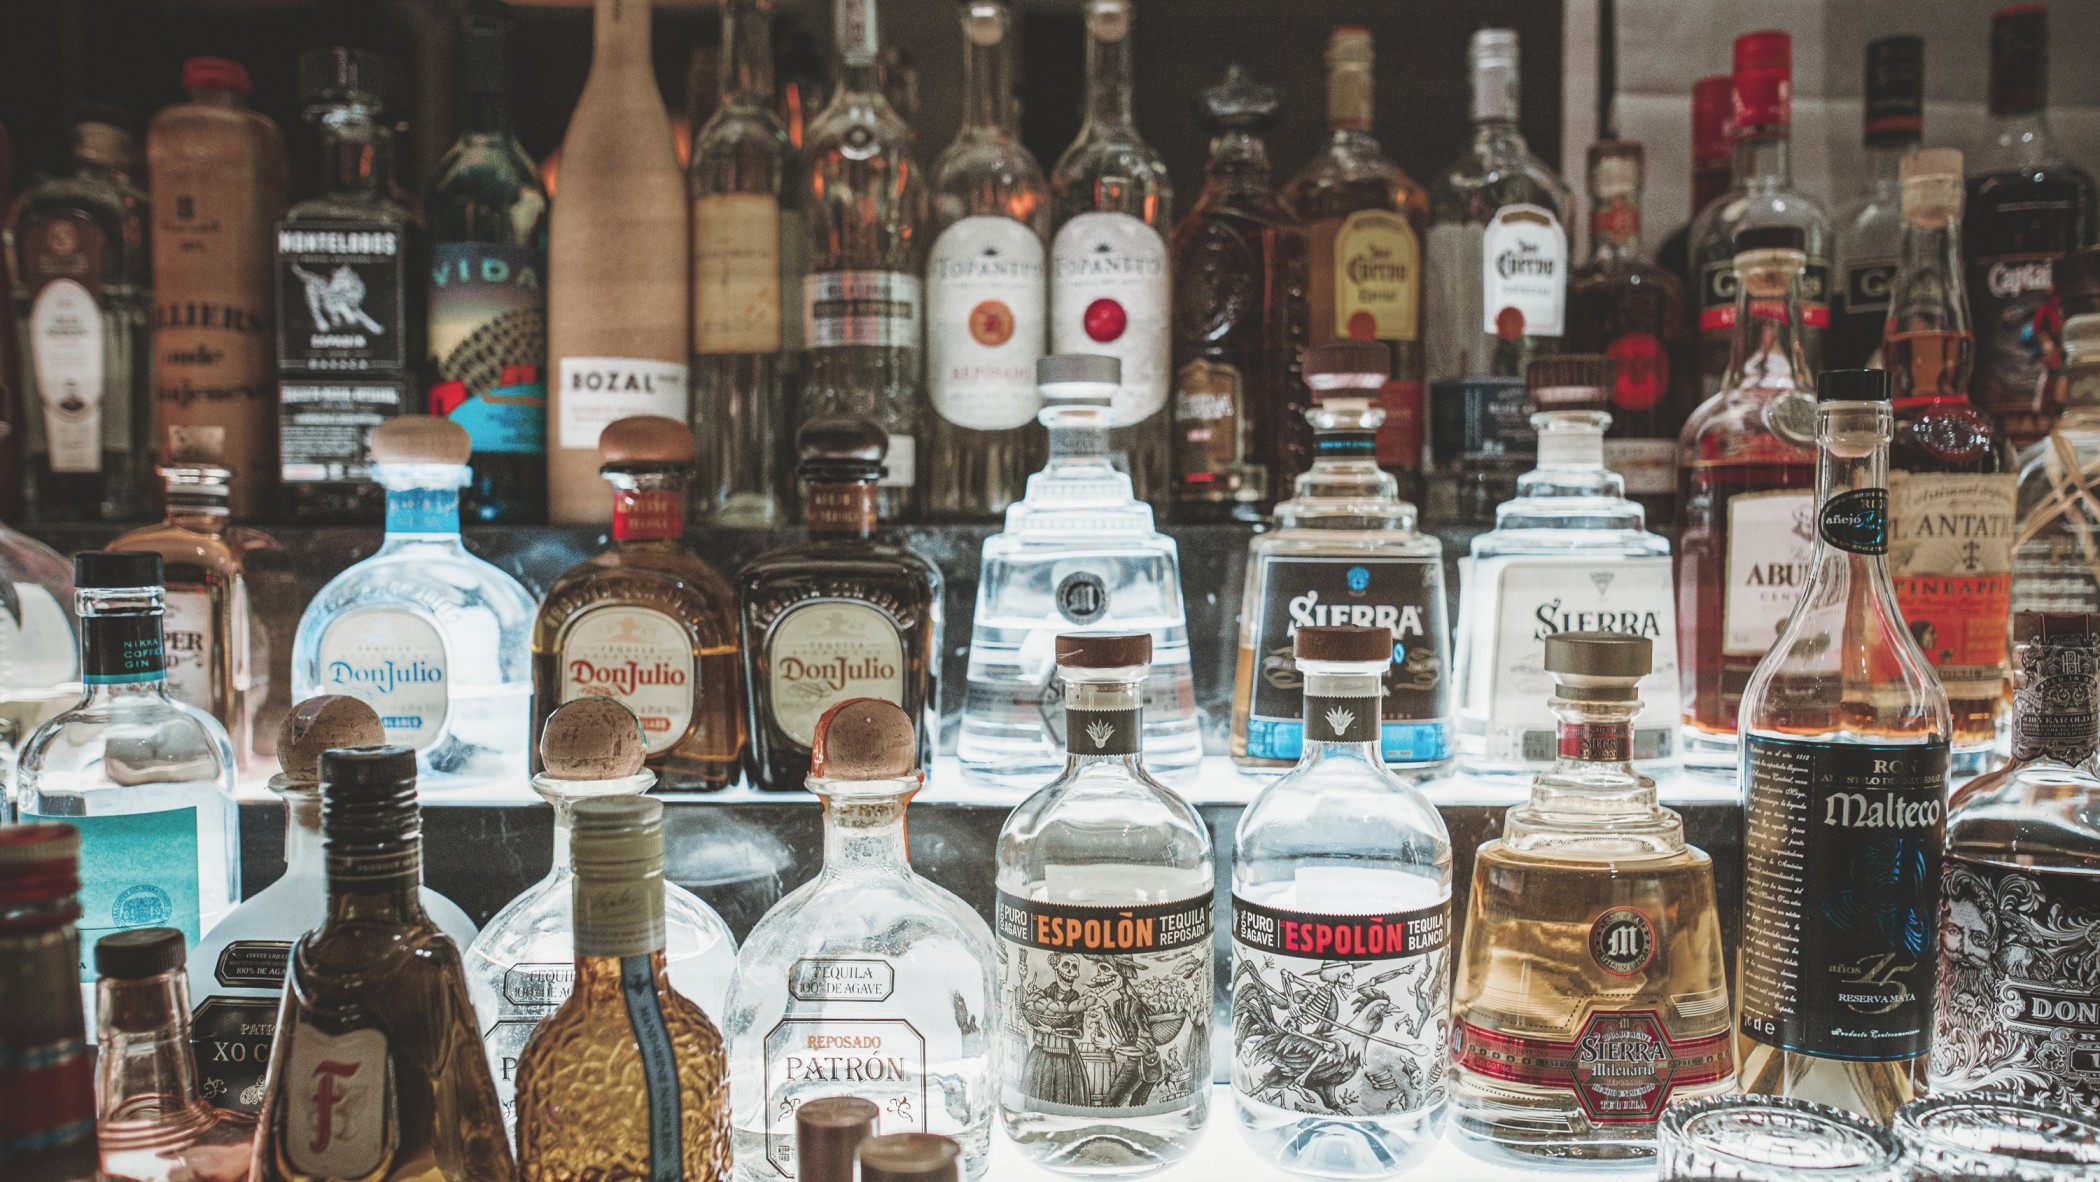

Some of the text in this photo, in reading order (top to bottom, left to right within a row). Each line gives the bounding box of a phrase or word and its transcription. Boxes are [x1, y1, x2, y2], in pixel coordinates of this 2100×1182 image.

[431, 257, 541, 288] VIDA
[1496, 250, 1555, 281] Cuervo
[572, 370, 657, 395] BOZAL
[1826, 513, 1861, 526] añejo
[1288, 590, 1423, 638] SIERRA
[1534, 599, 1661, 641] SIERRA
[123, 638, 160, 649] NIKKA
[124, 660, 149, 669] GIN
[1796, 753, 1810, 761] 1512
[1823, 792, 1941, 830] Malteco
[1004, 904, 1028, 926] PURO
[1159, 909, 1205, 933] TEQUILA
[1247, 912, 1274, 933] PURO
[1407, 913, 1444, 935] TEQUILA
[1004, 923, 1028, 941] AGAVE
[1159, 924, 1206, 946] REPOSADO
[1246, 927, 1274, 947] AGAVE
[1408, 929, 1444, 951] BLANCO
[1608, 925, 1639, 957] M
[256, 967, 268, 975] DE
[812, 966, 874, 980] TEQUILA
[1828, 963, 1861, 975] años
[826, 983, 843, 995] DE
[843, 984, 883, 996] AGAVE
[1838, 993, 1916, 1004] RESERVA MAYA
[2031, 997, 2099, 1025] DON
[807, 1035, 882, 1051] REPOSADO
[1830, 1027, 1868, 1039] Producto
[212, 1041, 246, 1062] XO
[1580, 1032, 1667, 1064] SIERRA
[786, 1050, 906, 1082] PATRÓN
[1592, 1063, 1655, 1077] Milenario
[1600, 1100, 1648, 1111] TEQUILA
